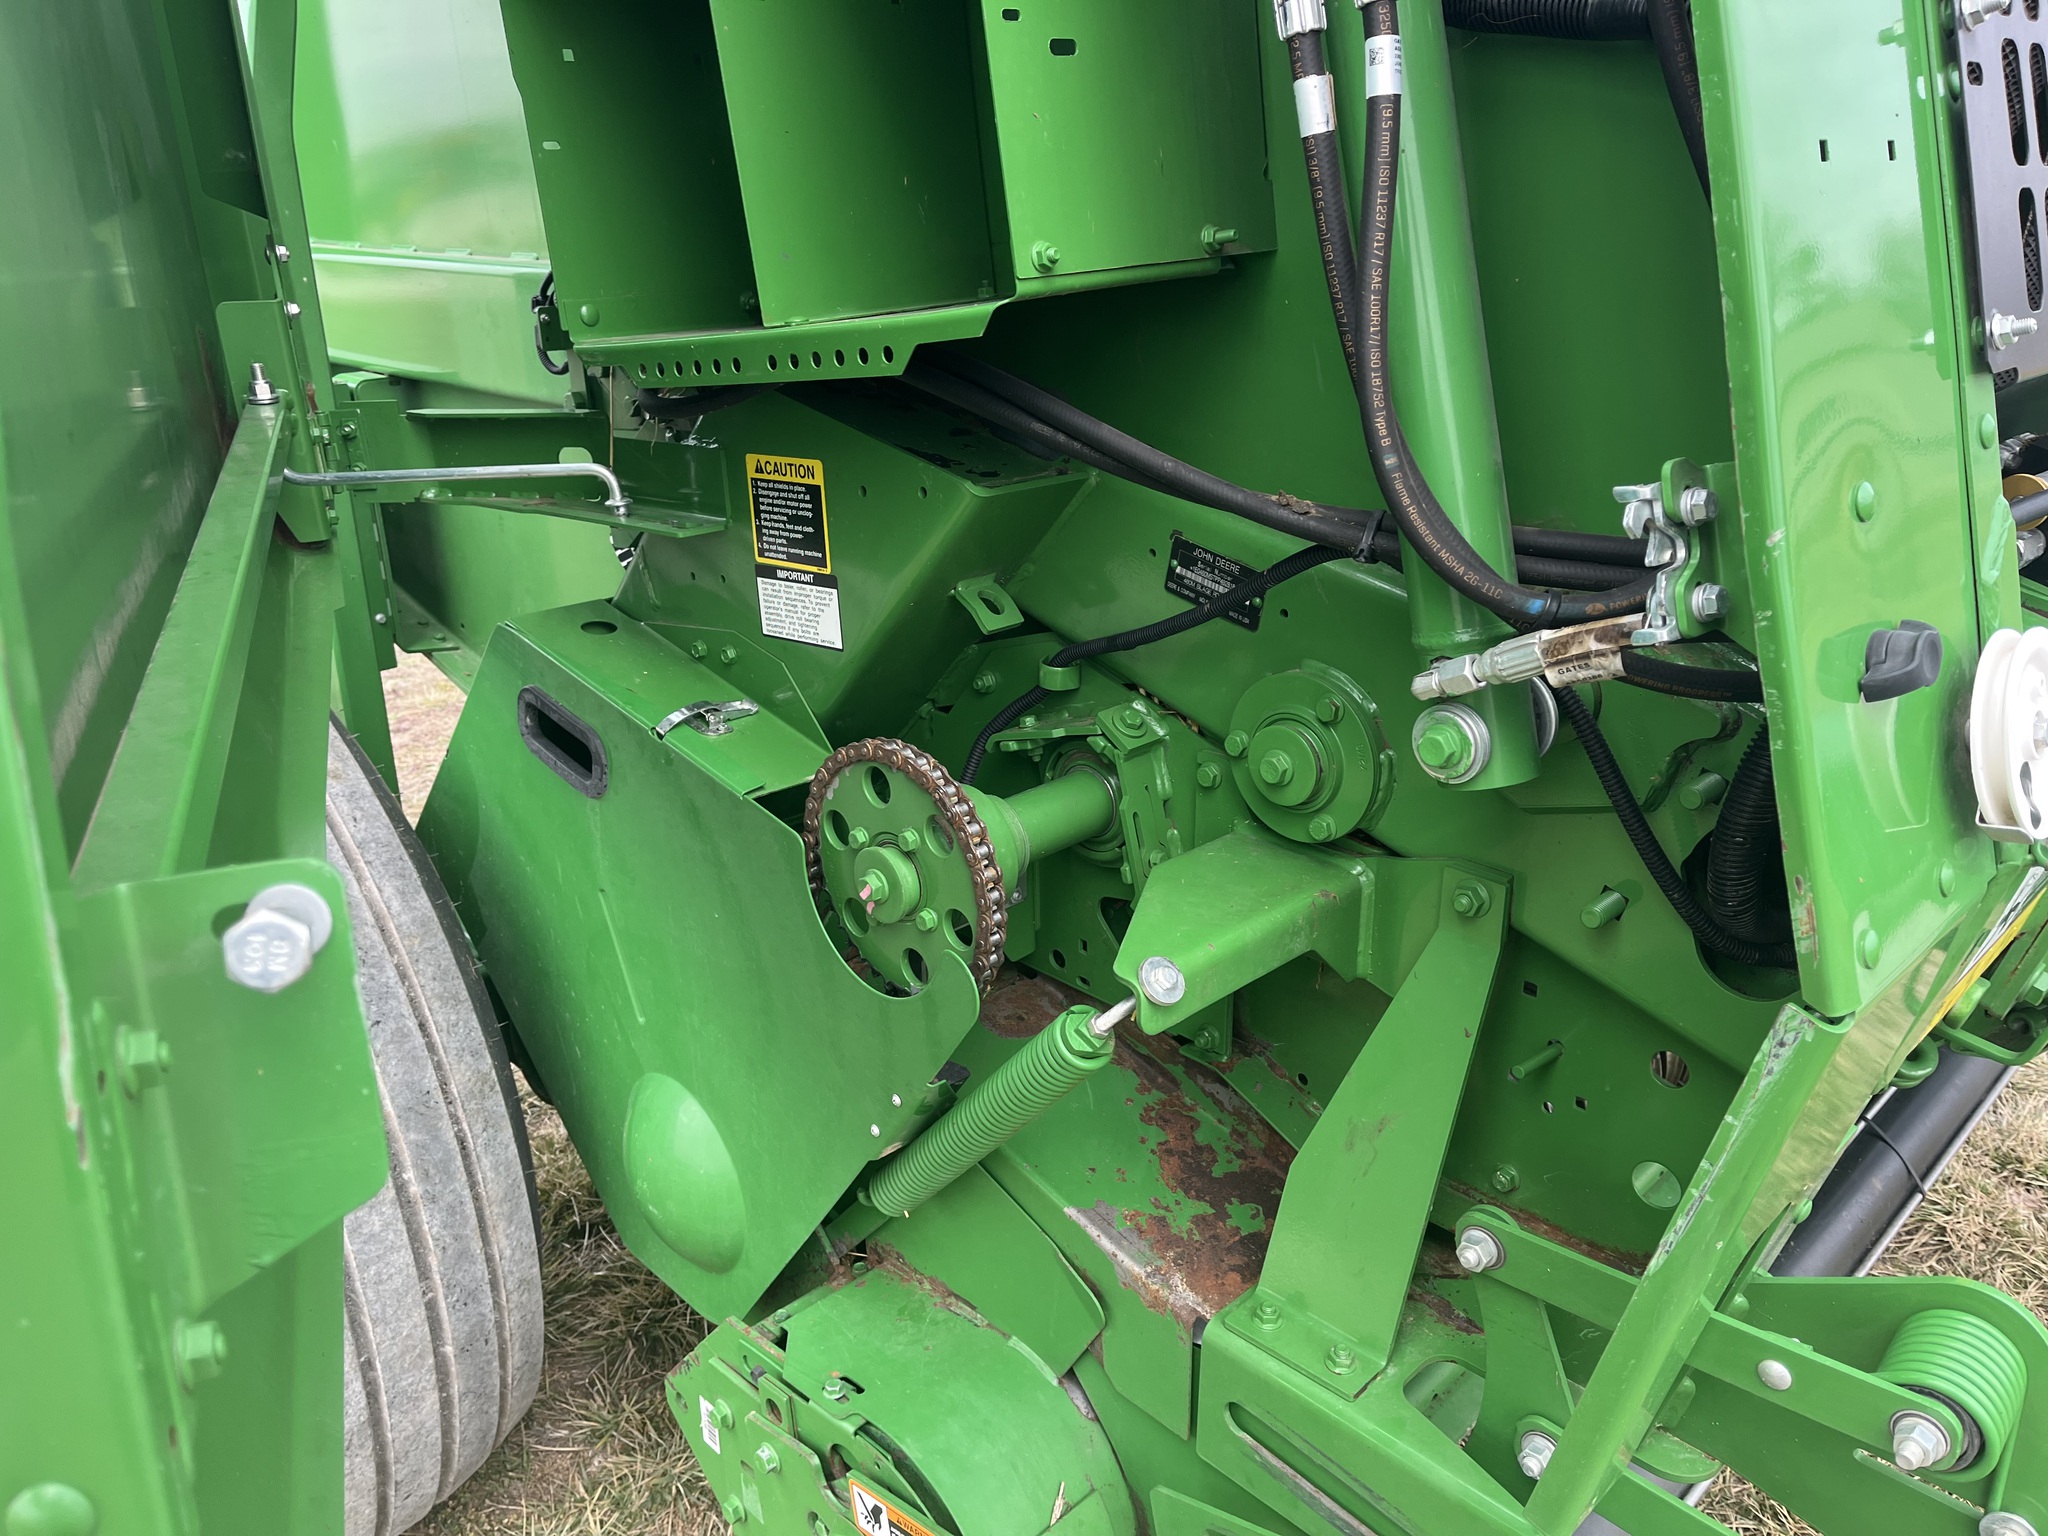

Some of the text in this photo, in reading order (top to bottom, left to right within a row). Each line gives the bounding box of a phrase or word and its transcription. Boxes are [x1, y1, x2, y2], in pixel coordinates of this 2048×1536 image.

[1378, 165, 1391, 186] ISO
[1375, 190, 1388, 228] 11237
[1322, 241, 1334, 260] ISO
[1373, 233, 1385, 256] R17
[1327, 263, 1342, 298] 11237
[1371, 268, 1382, 290] SAE
[1334, 302, 1347, 323] R17
[1342, 334, 1355, 354] SAE
[1370, 348, 1381, 368] ISO
[1370, 372, 1384, 409] 18752
[1374, 410, 1388, 437] Type
[1381, 437, 1392, 447] B
[764, 461, 815, 480] CAUTION
[1392, 472, 1411, 507] Flame
[773, 506, 791, 515] servicing
[1407, 505, 1441, 553] Resistant
[788, 547, 804, 556] running
[1193, 548, 1240, 574] JOHN DEERE
[1438, 548, 1465, 577] MSHA
[777, 569, 814, 583] IMPORTANT
[804, 617, 819, 625] bearing
[1557, 662, 1591, 676] GATES
[1626, 673, 1671, 692] OWERING
